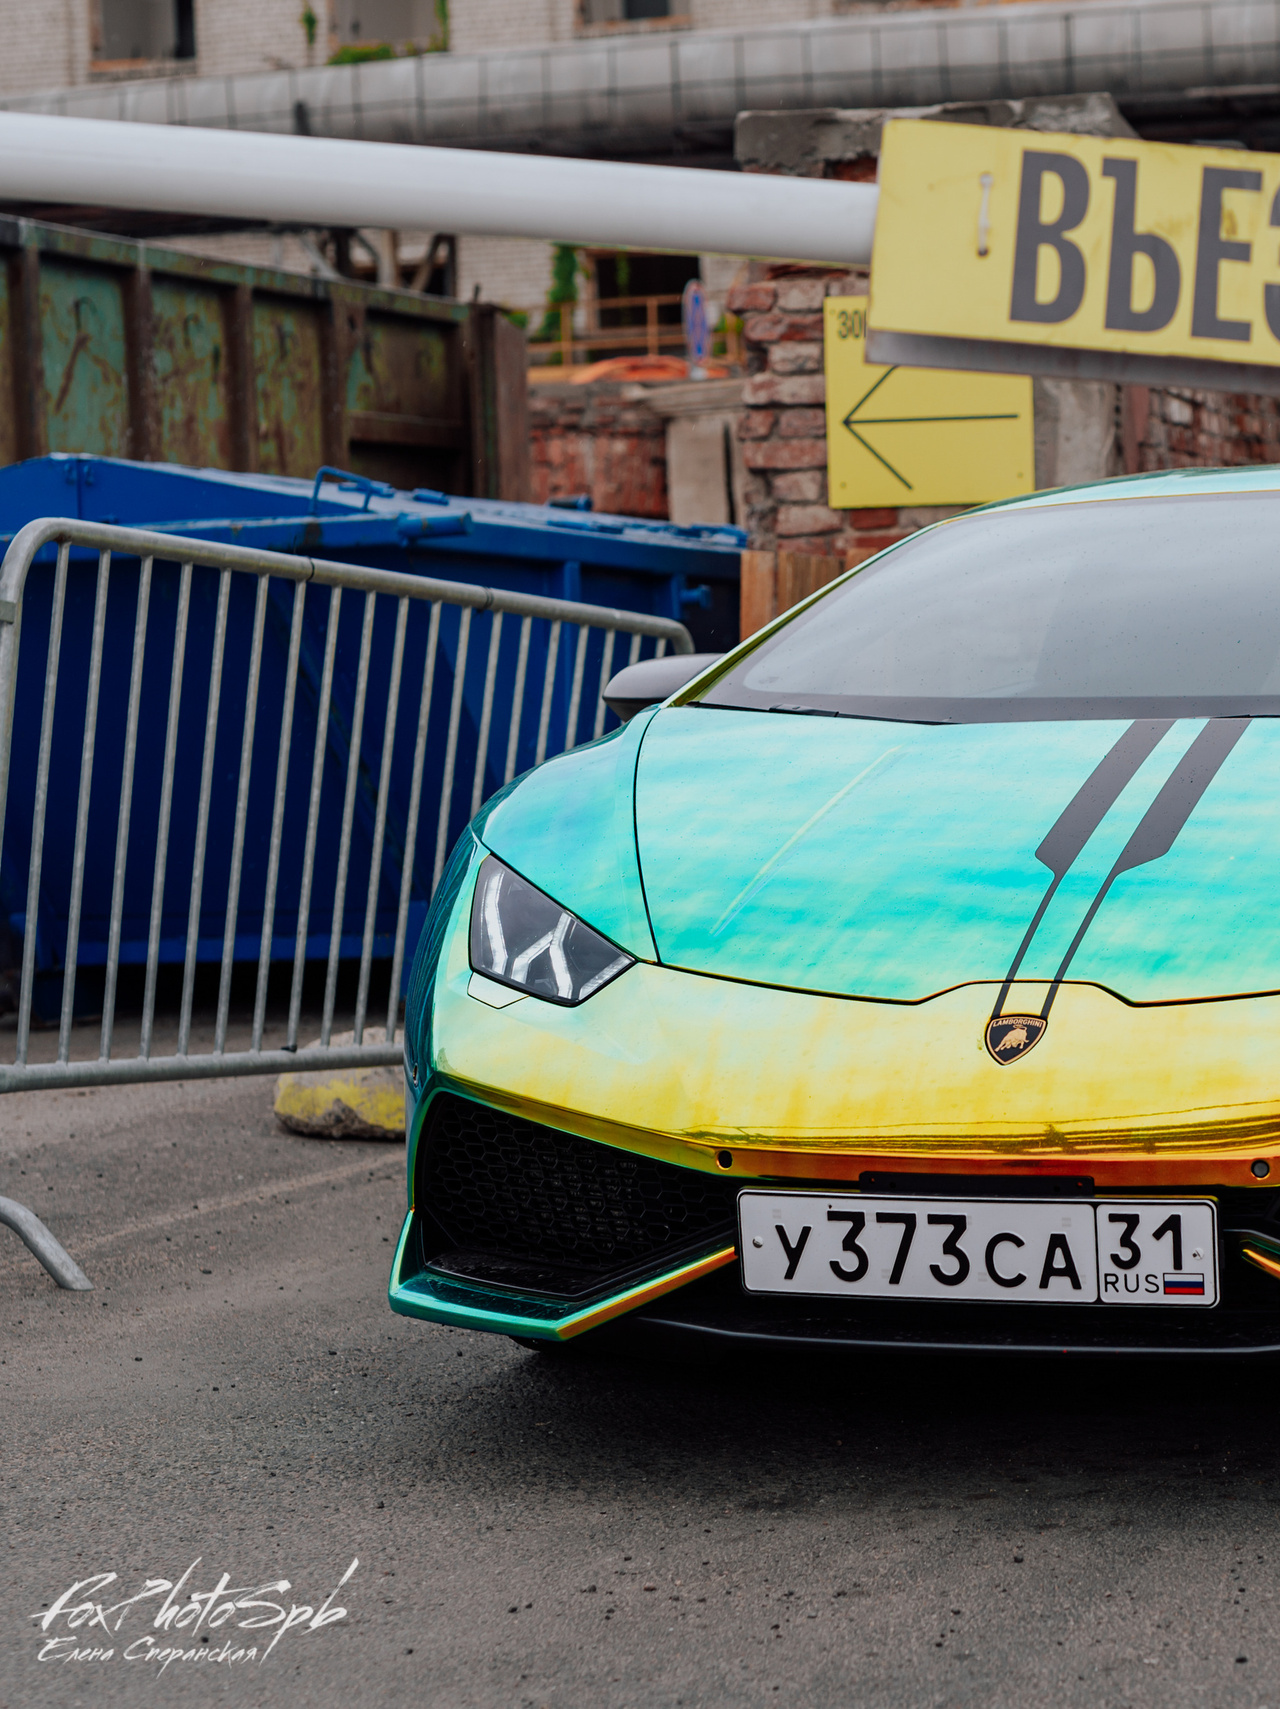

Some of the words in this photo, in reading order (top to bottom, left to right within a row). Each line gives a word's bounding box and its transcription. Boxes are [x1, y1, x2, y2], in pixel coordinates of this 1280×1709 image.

[993, 1018, 1042, 1028] LAMBORGHINI
[1108, 1212, 1183, 1271] 31
[1104, 1272, 1160, 1294] RUS
